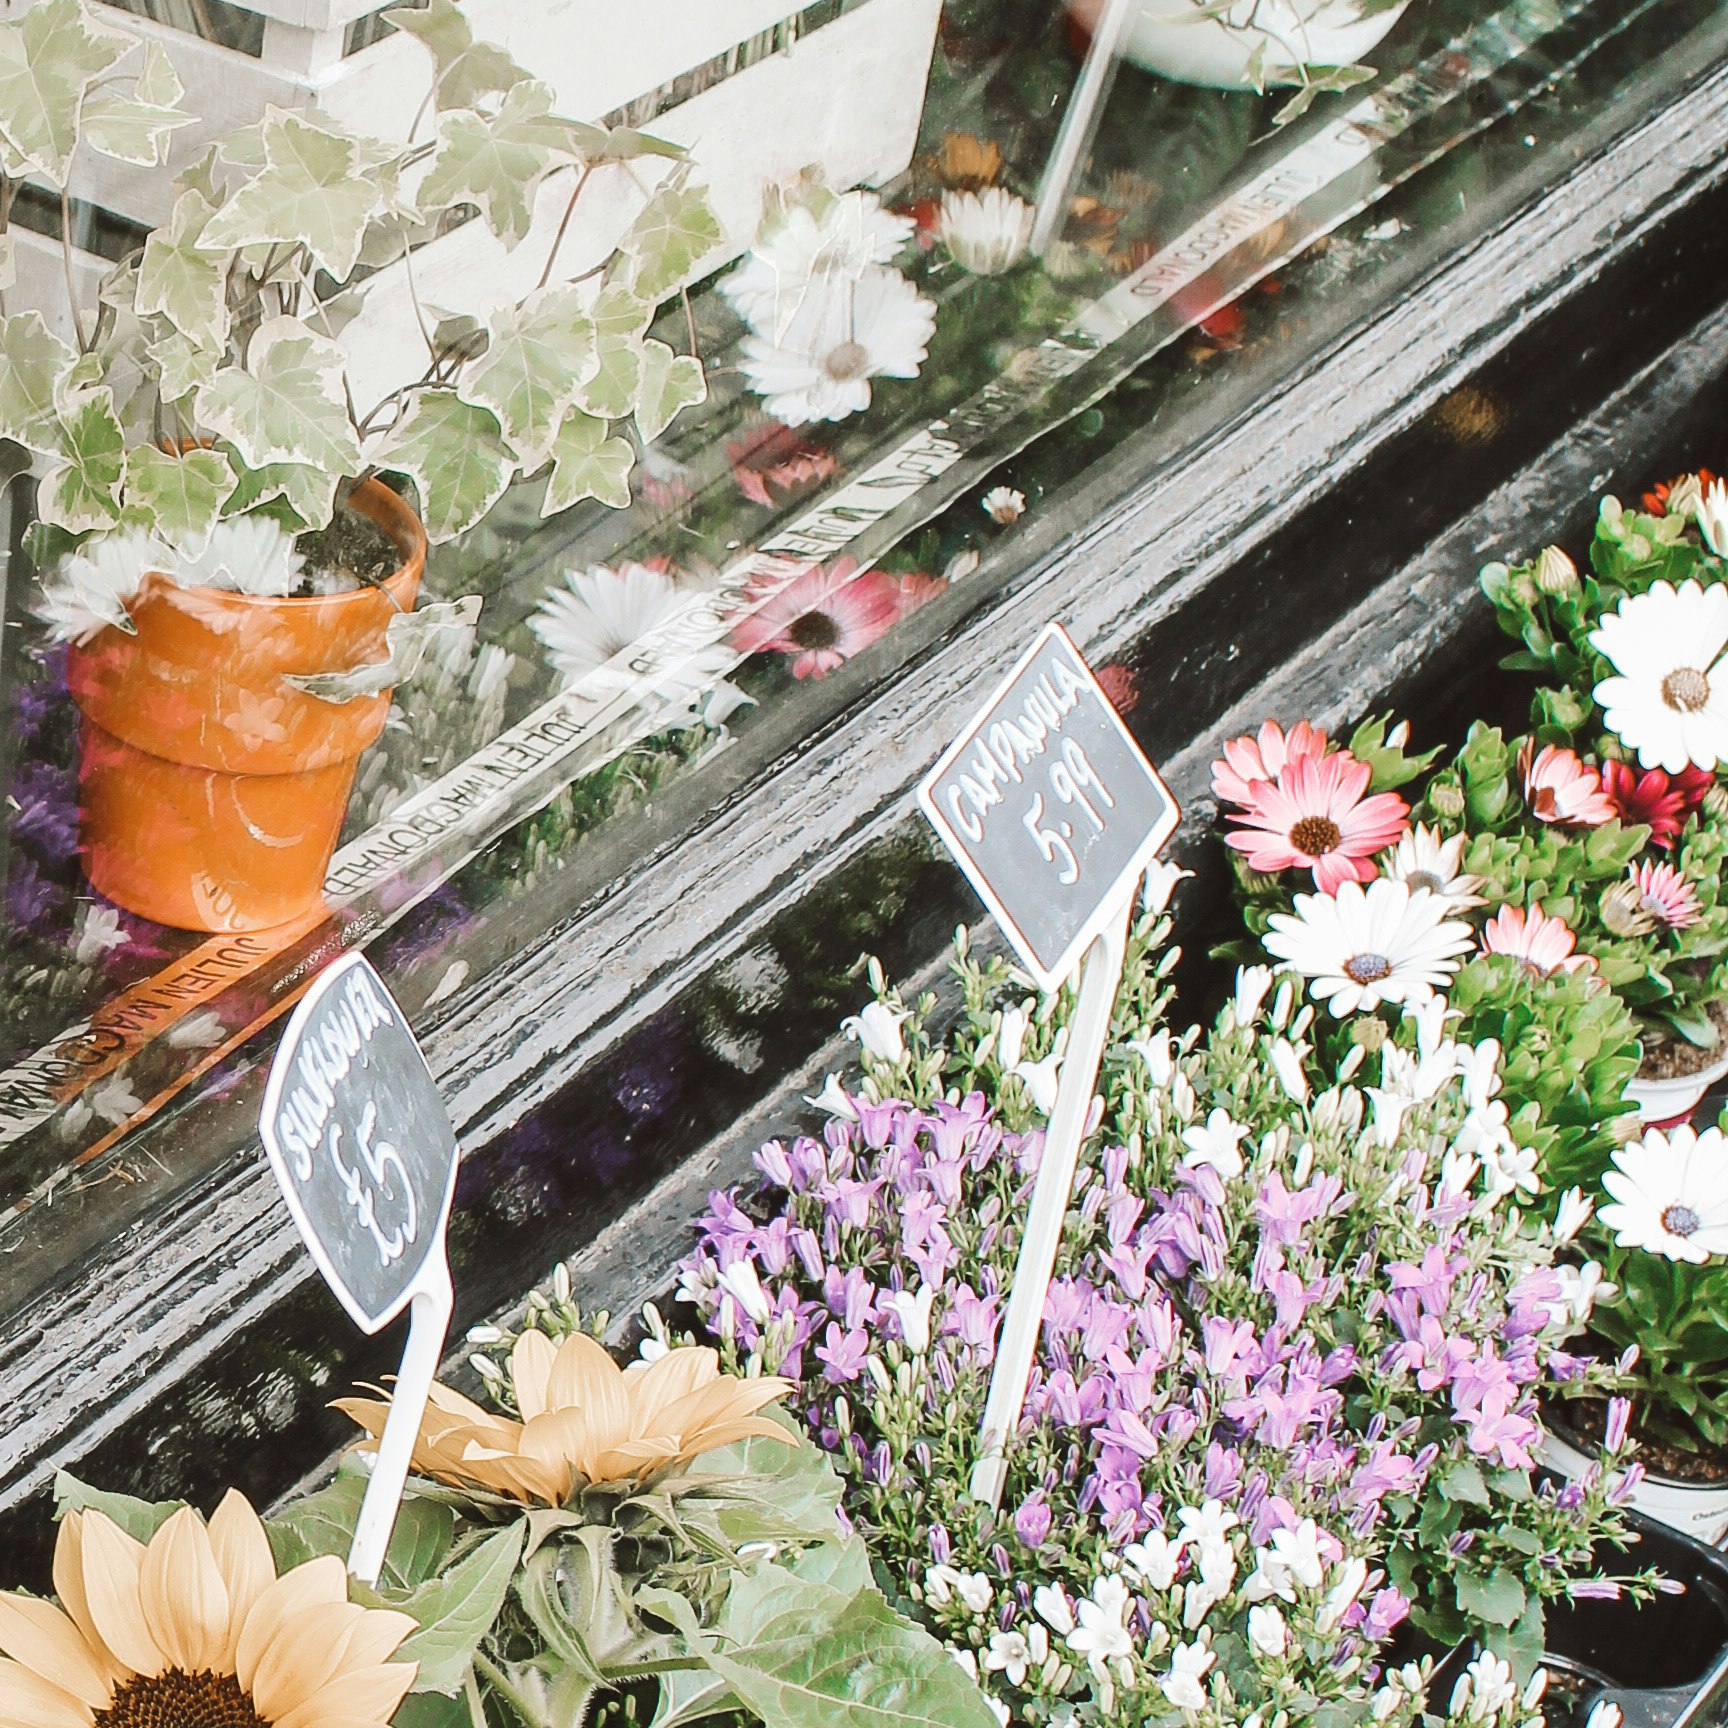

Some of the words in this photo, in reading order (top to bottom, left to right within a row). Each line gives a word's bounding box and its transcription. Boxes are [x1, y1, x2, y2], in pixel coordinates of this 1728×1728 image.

[483, 710, 589, 784] JULIEN
[322, 772, 500, 897] MACDONALD
[1022, 736, 1115, 886] 5.99
[152, 936, 270, 1001] JULIEN
